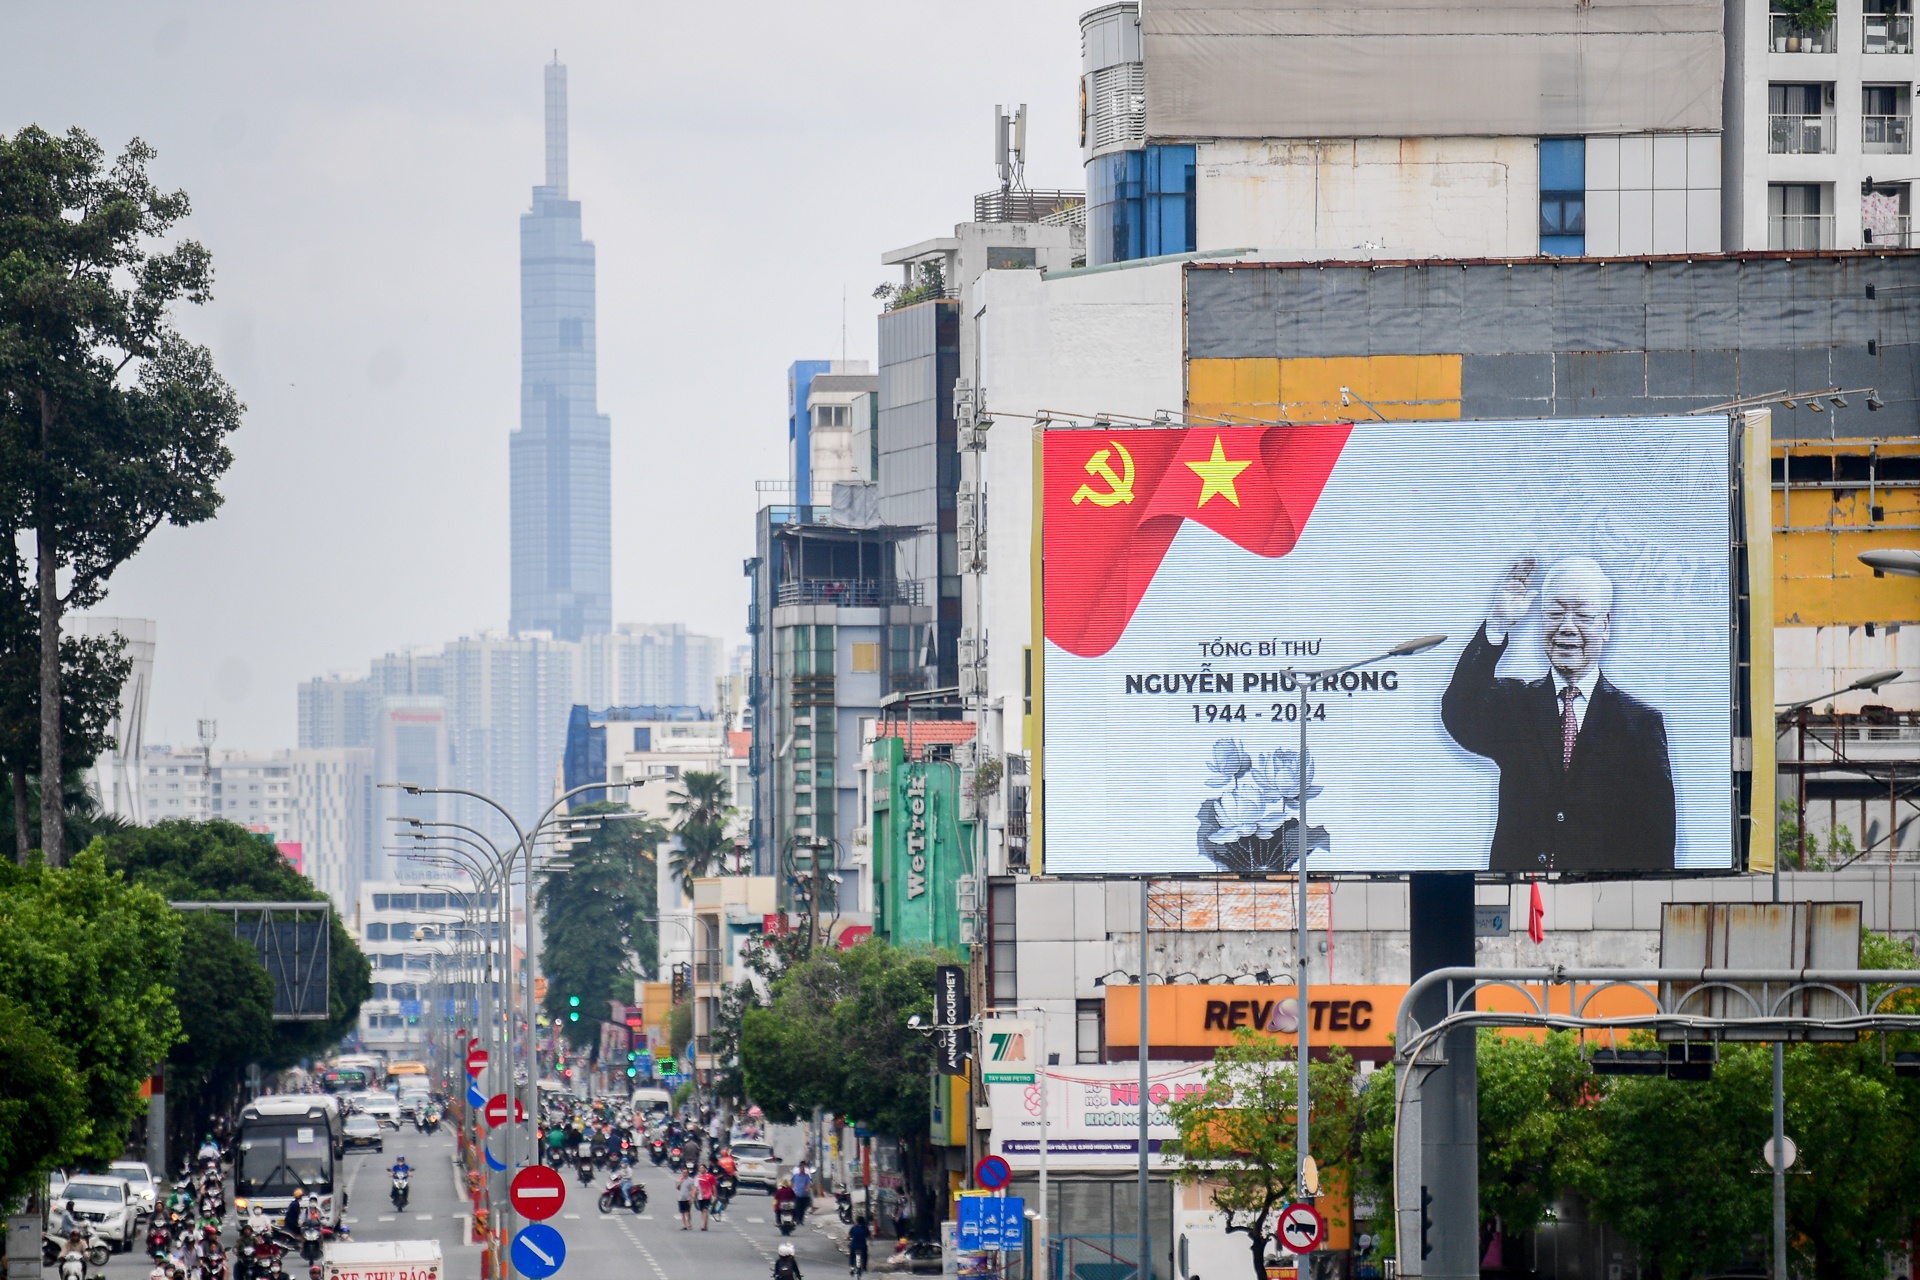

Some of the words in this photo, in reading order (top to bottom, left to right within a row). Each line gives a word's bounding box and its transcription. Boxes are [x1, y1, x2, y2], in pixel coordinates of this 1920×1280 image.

[1199, 637, 1252, 657] TỔNG
[1258, 637, 1277, 656] BÍ
[1281, 638, 1322, 656] THƯ
[1126, 662, 1234, 694] NGUYỄN
[1243, 666, 1297, 692] PHÚ
[1305, 670, 1399, 697] TRỌNG
[1192, 704, 1247, 723] 1944
[946, 971, 957, 1025] GOURMET
[947, 1026, 957, 1068] ANNAM
